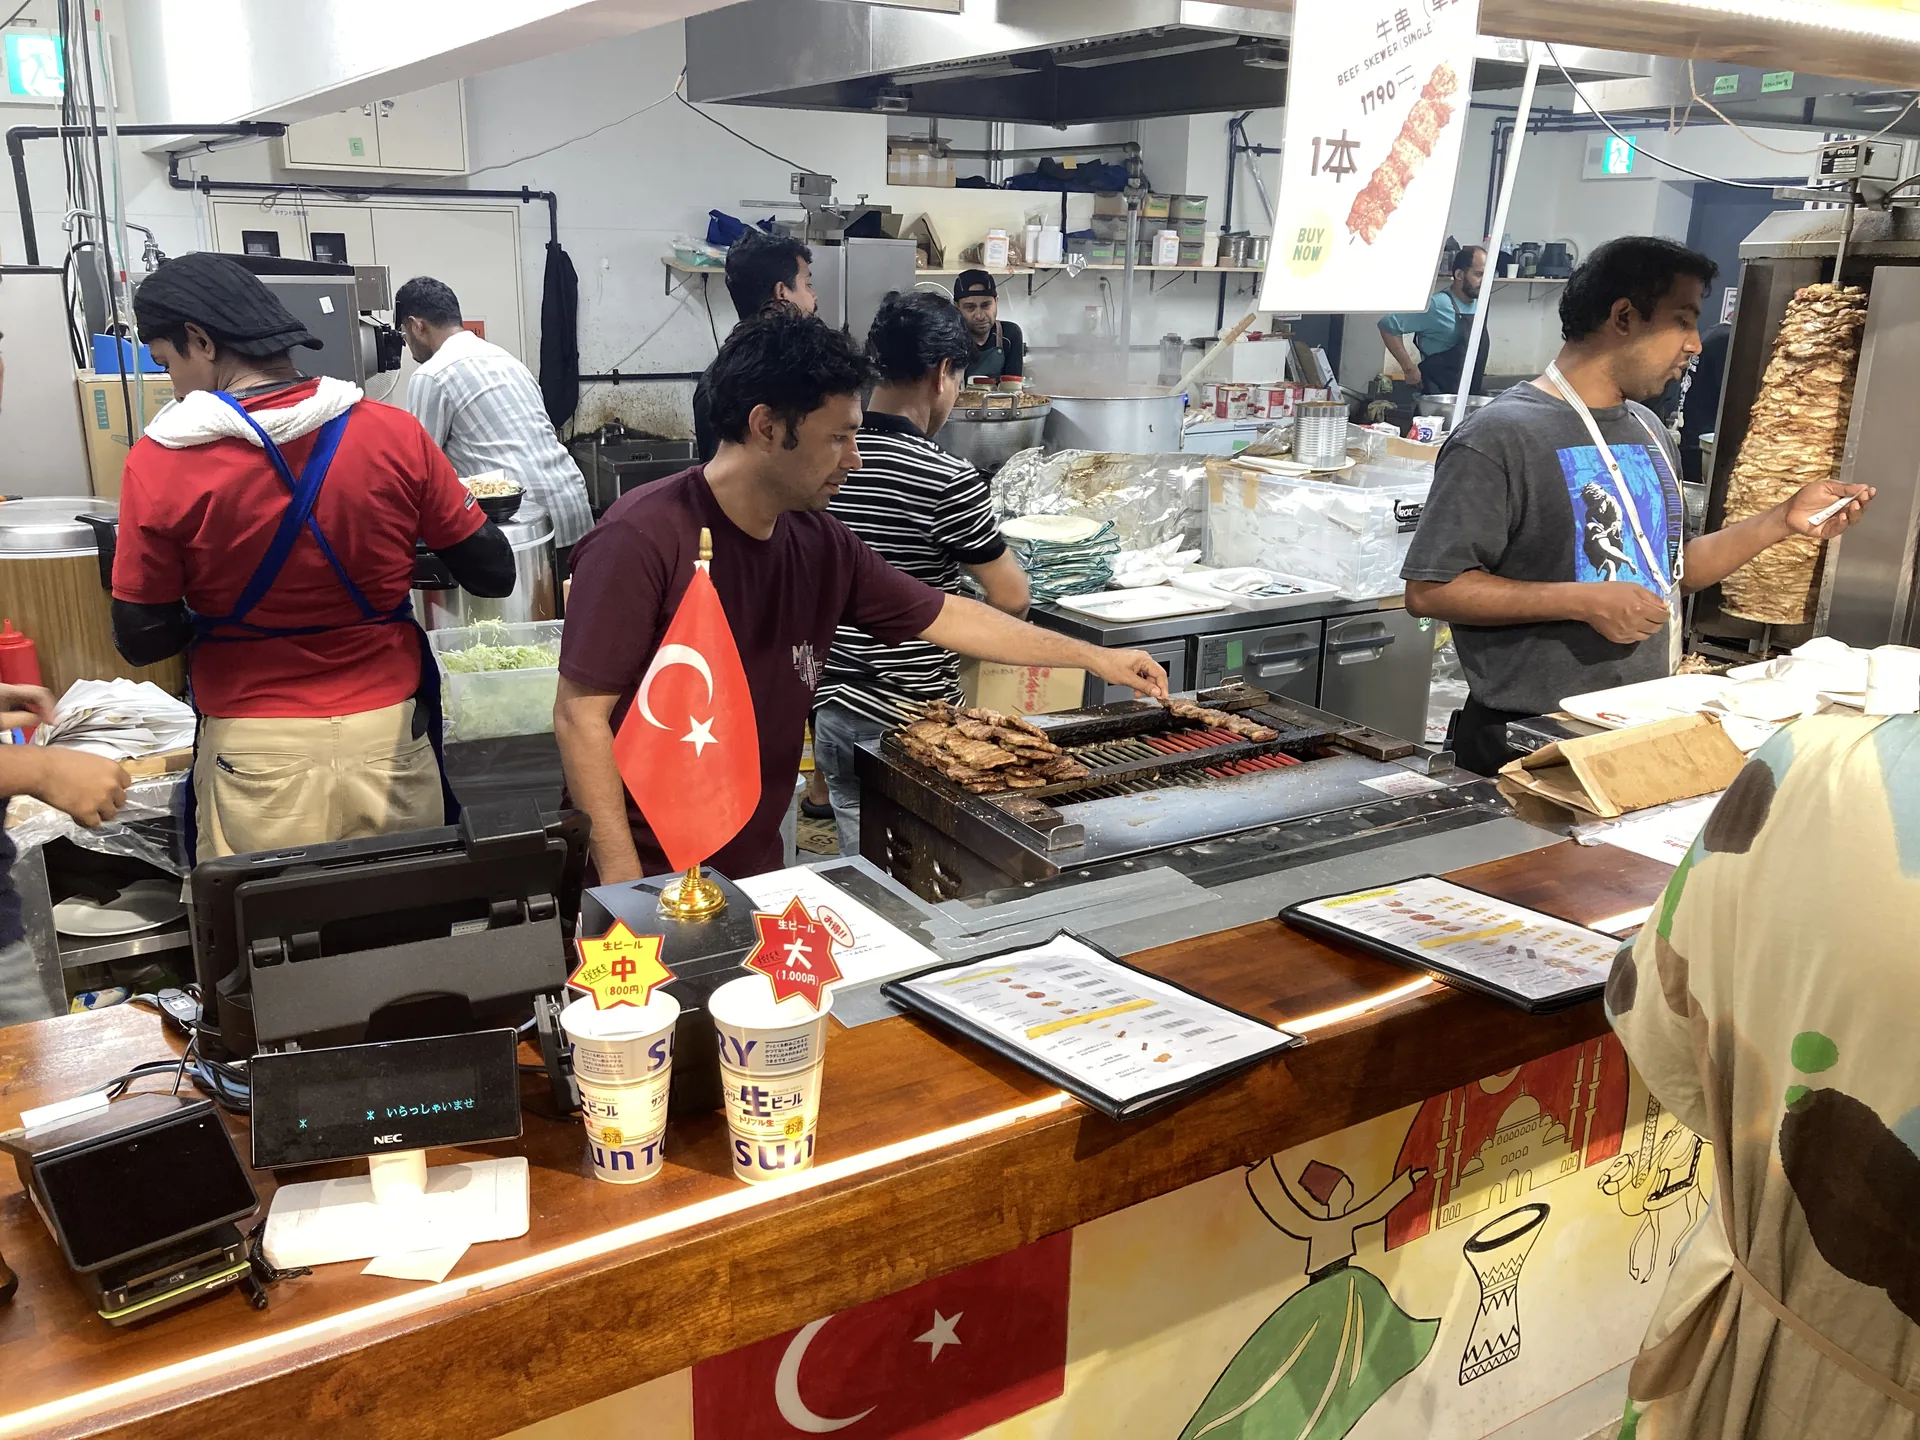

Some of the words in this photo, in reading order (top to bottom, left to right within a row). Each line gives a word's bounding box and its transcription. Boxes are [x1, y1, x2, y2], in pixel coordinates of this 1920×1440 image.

[1338, 64, 1360, 86] BEEF
[1311, 129, 1361, 183] 1本
[1297, 227, 1325, 243] BUY
[1293, 245, 1322, 261] NOW
[778, 919, 816, 934] 生ビール
[823, 914, 848, 939] お得!!
[602, 940, 644, 952] 生ビール
[783, 937, 813, 970] 大
[611, 955, 637, 982] 中
[604, 984, 645, 996] (800円)
[386, 1097, 475, 1118] いらっしゃいませ
[785, 1119, 804, 1135] お酒
[373, 1133, 403, 1145] NEC
[602, 1130, 622, 1144] お酒
